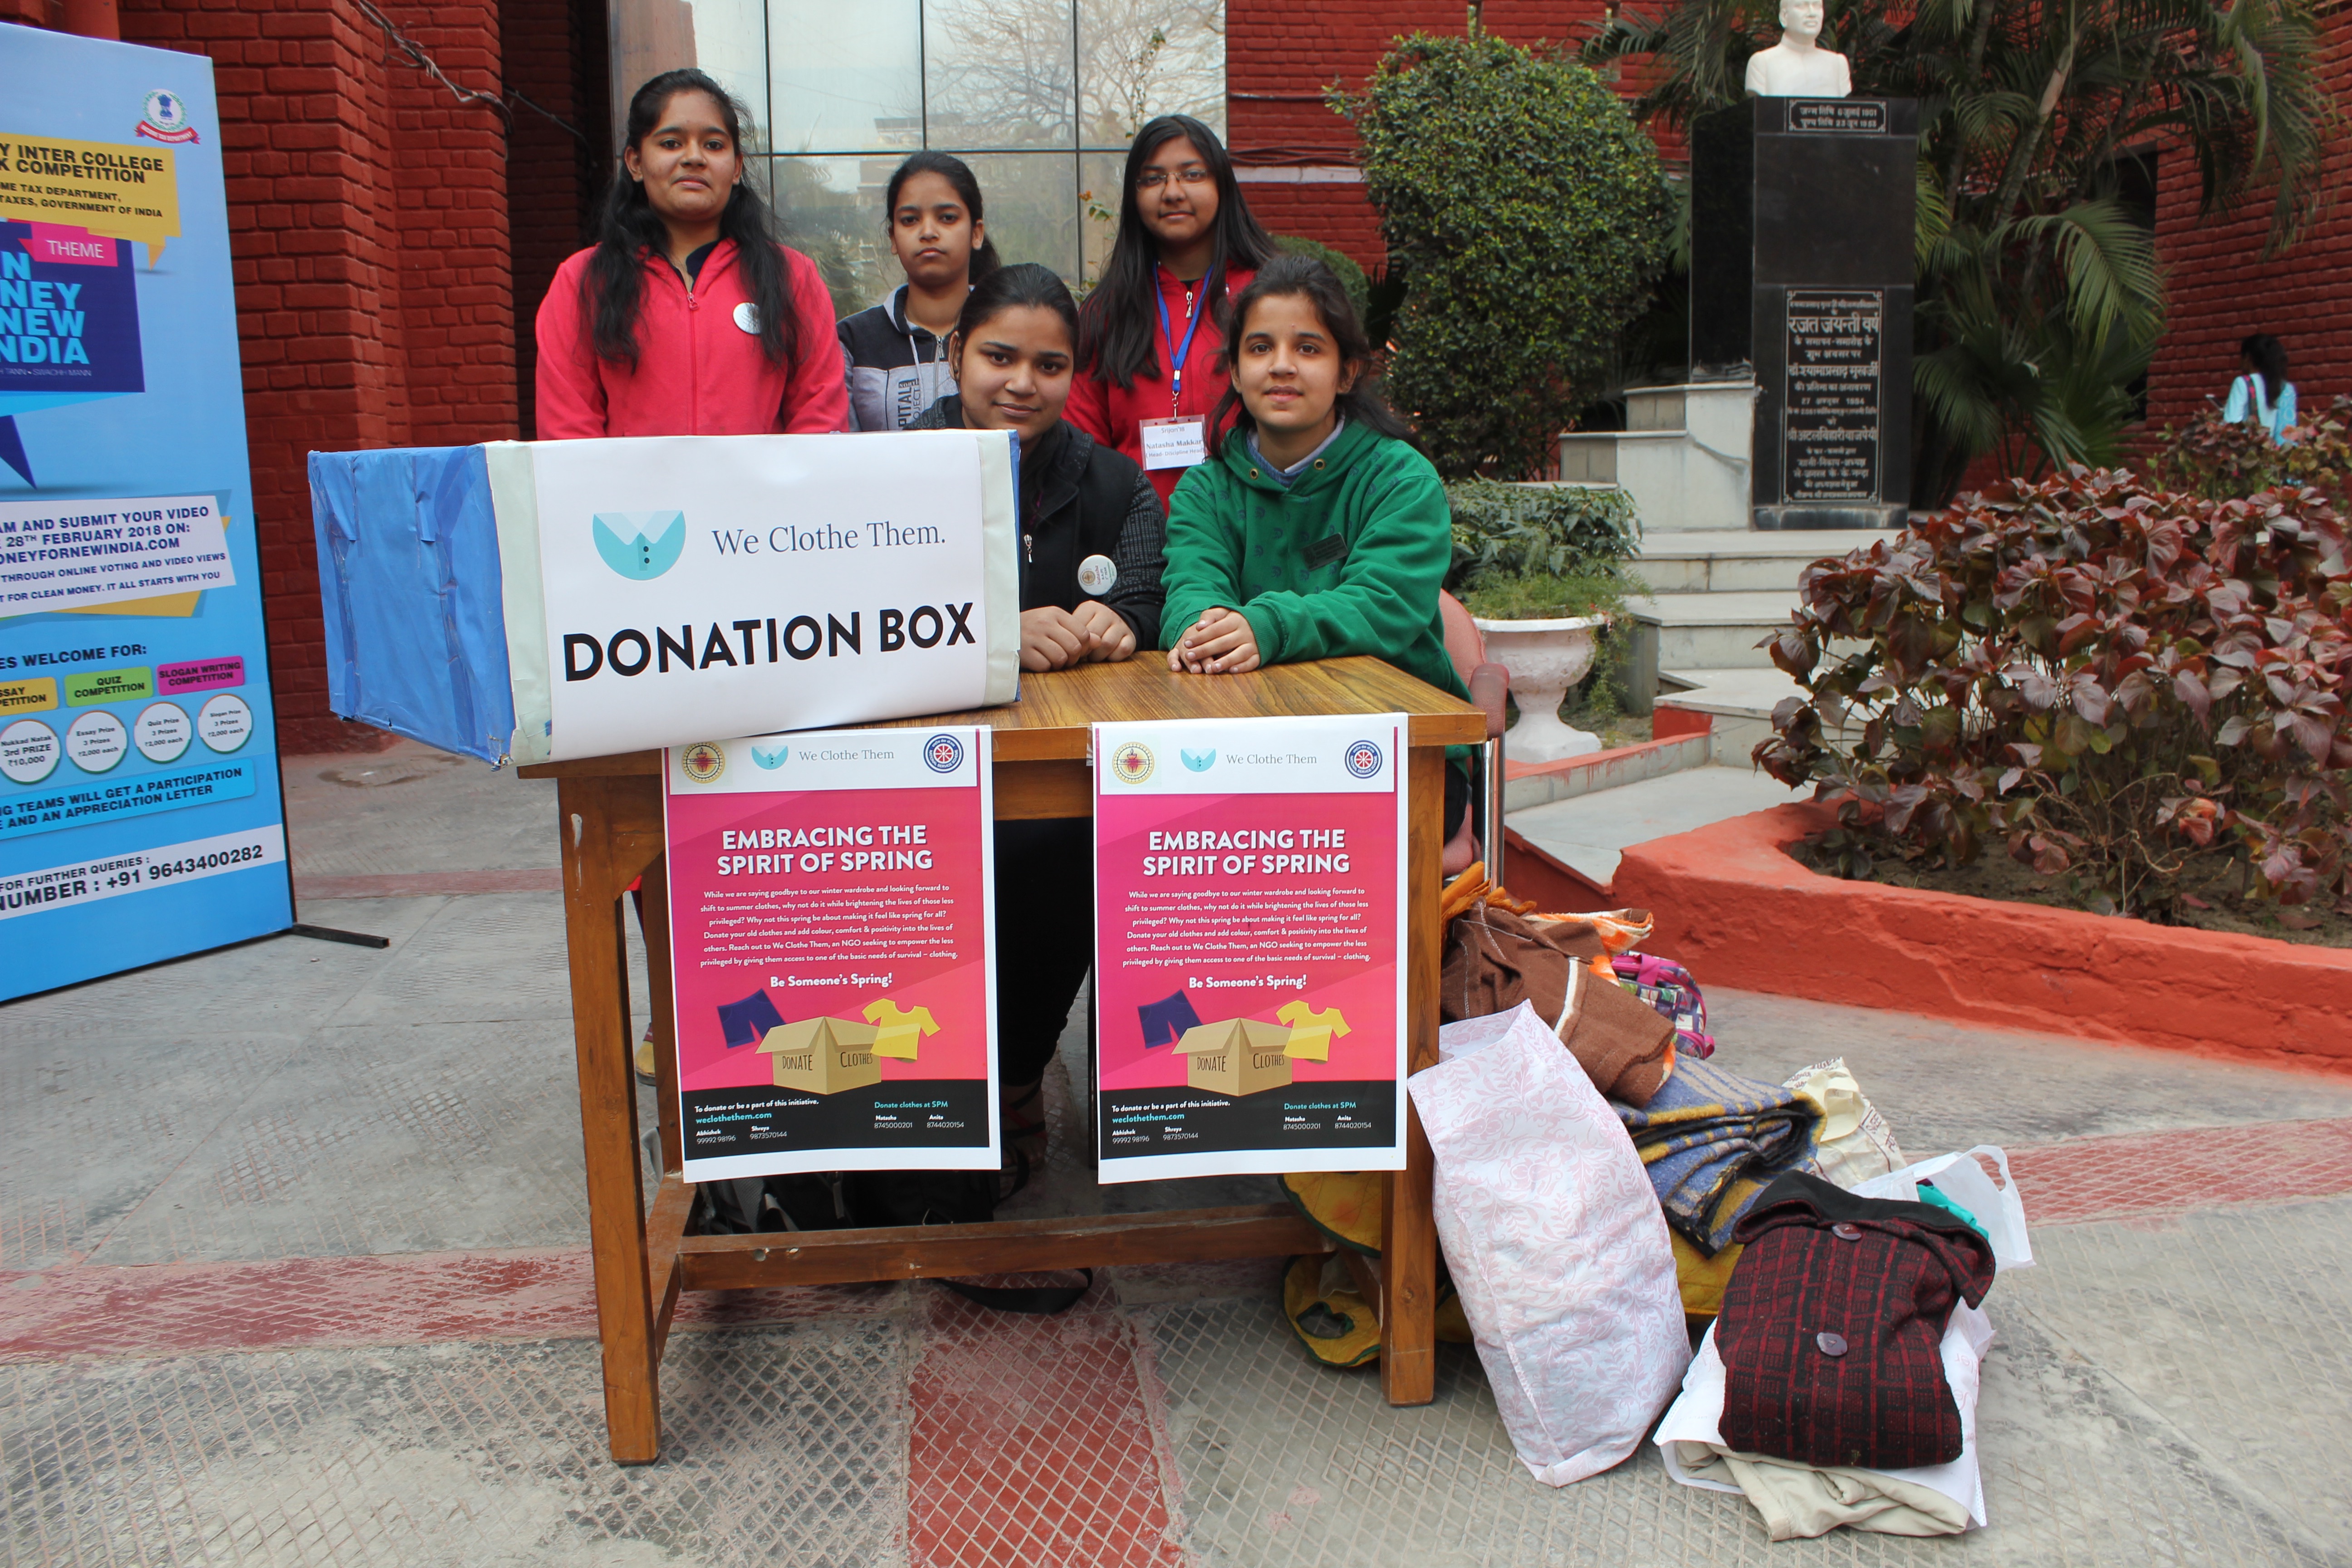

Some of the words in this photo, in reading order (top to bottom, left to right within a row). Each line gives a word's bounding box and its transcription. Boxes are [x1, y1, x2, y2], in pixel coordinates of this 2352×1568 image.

[18, 145, 76, 163] INTER
[82, 152, 163, 172] COLLEGE
[16, 159, 145, 183] COMPETITION
[20, 184, 43, 193] TAX
[46, 187, 121, 202] DEPARTMENT,
[41, 199, 115, 213] GOVERNMENT
[135, 208, 162, 217] INDIA
[45, 240, 104, 258] THEME
[0, 308, 85, 337] NEW
[1789, 316, 1818, 333] रजत
[23, 519, 54, 531] AND
[60, 514, 117, 528] SUBMIT
[122, 510, 162, 523] YOUR
[167, 506, 208, 519] VIDEO
[43, 528, 122, 545] FEBRUARY
[128, 525, 161, 537] 2018
[166, 523, 190, 534] ON:
[712, 529, 759, 555] We
[769, 524, 858, 552] Clothe
[867, 521, 945, 546] Them.
[0, 570, 55, 582] THROUGH
[59, 566, 97, 577] ONLINE
[100, 562, 138, 572] VOTING
[142, 560, 162, 568] AND
[165, 556, 193, 565] VIDEO
[196, 553, 225, 562] VIEWS
[8, 593, 28, 601] FOR
[31, 589, 64, 599] CLEAN
[67, 585, 104, 595] MONEY.
[139, 577, 174, 587] STARTS
[176, 574, 199, 582] WITH
[564, 612, 860, 681] DONATION
[880, 603, 975, 652] BOX
[22, 648, 106, 666] WELCOME
[111, 644, 146, 657] FOR:
[159, 667, 198, 678] SLOGAN
[201, 662, 240, 673] WRITING
[169, 672, 233, 686] COMPETITION
[74, 683, 145, 697] COMPETITION
[97, 676, 122, 686] QUIZ
[23, 744, 51, 754] PRIZE
[799, 751, 817, 760] We
[821, 750, 858, 760] Clothe
[862, 750, 894, 759] Them
[1226, 755, 1243, 764] We
[1247, 754, 1283, 764] Clothe
[1286, 754, 1317, 764] Them
[17, 797, 65, 813] TEAMS
[69, 792, 102, 804] WILL
[105, 786, 131, 798] GET
[136, 784, 144, 794] A
[147, 768, 241, 791] PARTICIPATION
[8, 815, 37, 828] AND
[42, 811, 61, 822] AN
[66, 794, 162, 818] APPRECIATION
[167, 785, 212, 800] LETTER
[723, 827, 872, 849] EMBRACING
[878, 825, 926, 844] THE
[1150, 830, 1293, 850] EMBRACING
[1300, 829, 1344, 848] THE
[28, 868, 86, 886] FURTHER
[91, 857, 142, 873] QUERIES
[107, 869, 140, 888] +91
[149, 845, 262, 880] 9643400282
[718, 854, 794, 875] SPIRIT
[800, 853, 833, 872] OF
[841, 850, 931, 871] SPRING
[1144, 856, 1217, 875] SPIRIT
[1223, 855, 1255, 874] OF
[1262, 854, 1349, 873] SPRING
[748, 890, 769, 898] saying
[771, 888, 799, 898] goodbye
[890, 885, 914, 894] looking
[771, 977, 784, 987] Be
[788, 974, 848, 986] Someone's
[851, 973, 892, 988] Spring!
[1190, 977, 1203, 988] Be
[1206, 975, 1263, 987] Someone's
[1267, 975, 1306, 990] Spring!
[782, 1054, 813, 1071] DONATE
[696, 1113, 772, 1123] weclothethem.com
[750, 1131, 787, 1139] 9873570144
